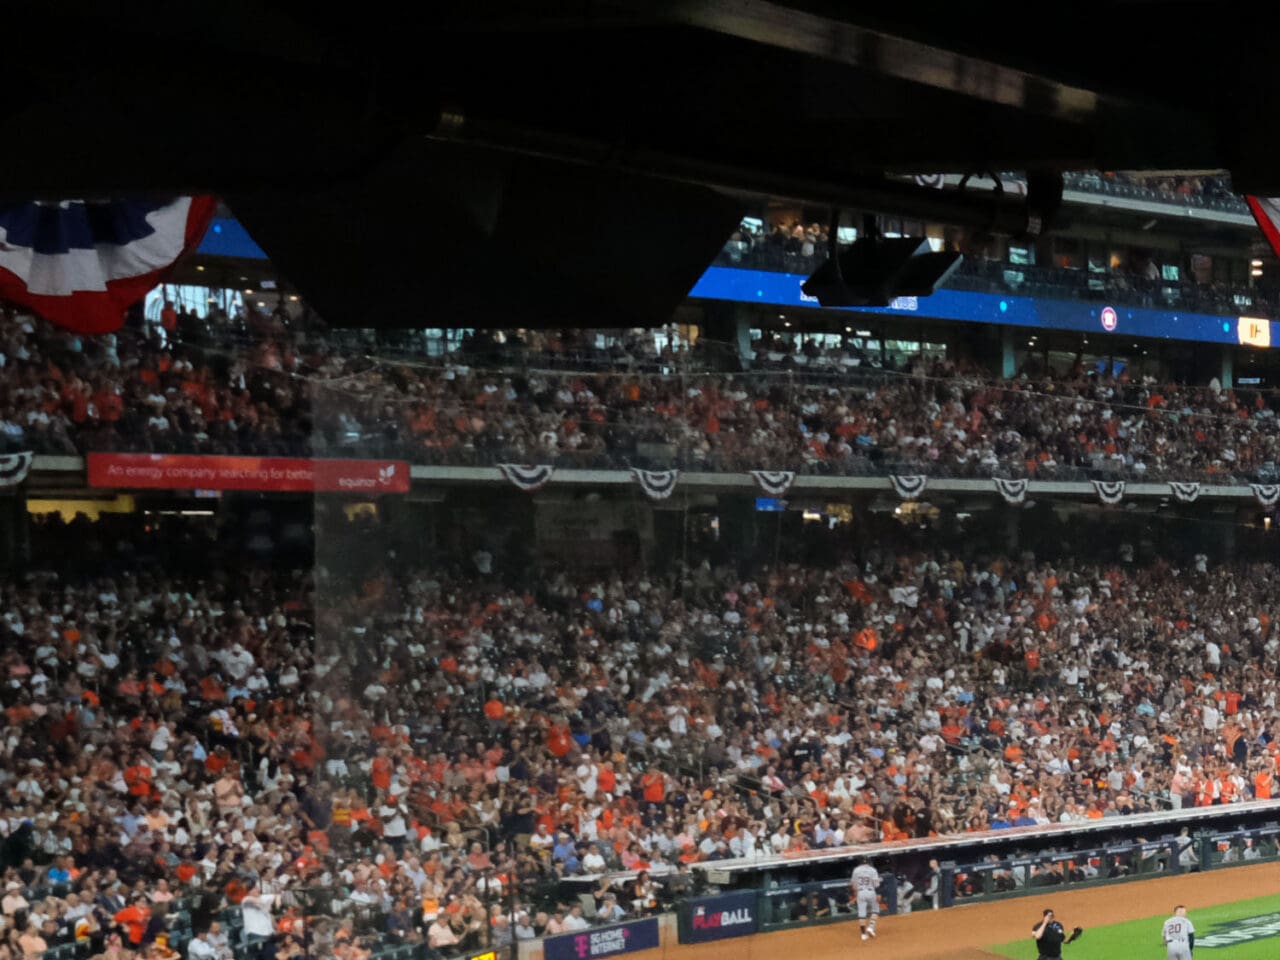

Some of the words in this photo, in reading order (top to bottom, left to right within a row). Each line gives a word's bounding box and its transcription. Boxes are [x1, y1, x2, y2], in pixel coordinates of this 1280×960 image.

[107, 464, 123, 475] An
[125, 466, 163, 479] energy
[166, 467, 216, 480] company
[219, 468, 269, 481] searching
[270, 468, 284, 479] for
[286, 469, 314, 480] bette
[338, 477, 376, 488] equinor
[602, 928, 623, 942] HOME
[1168, 923, 1181, 934] 20
[591, 939, 625, 955] INTERNET
